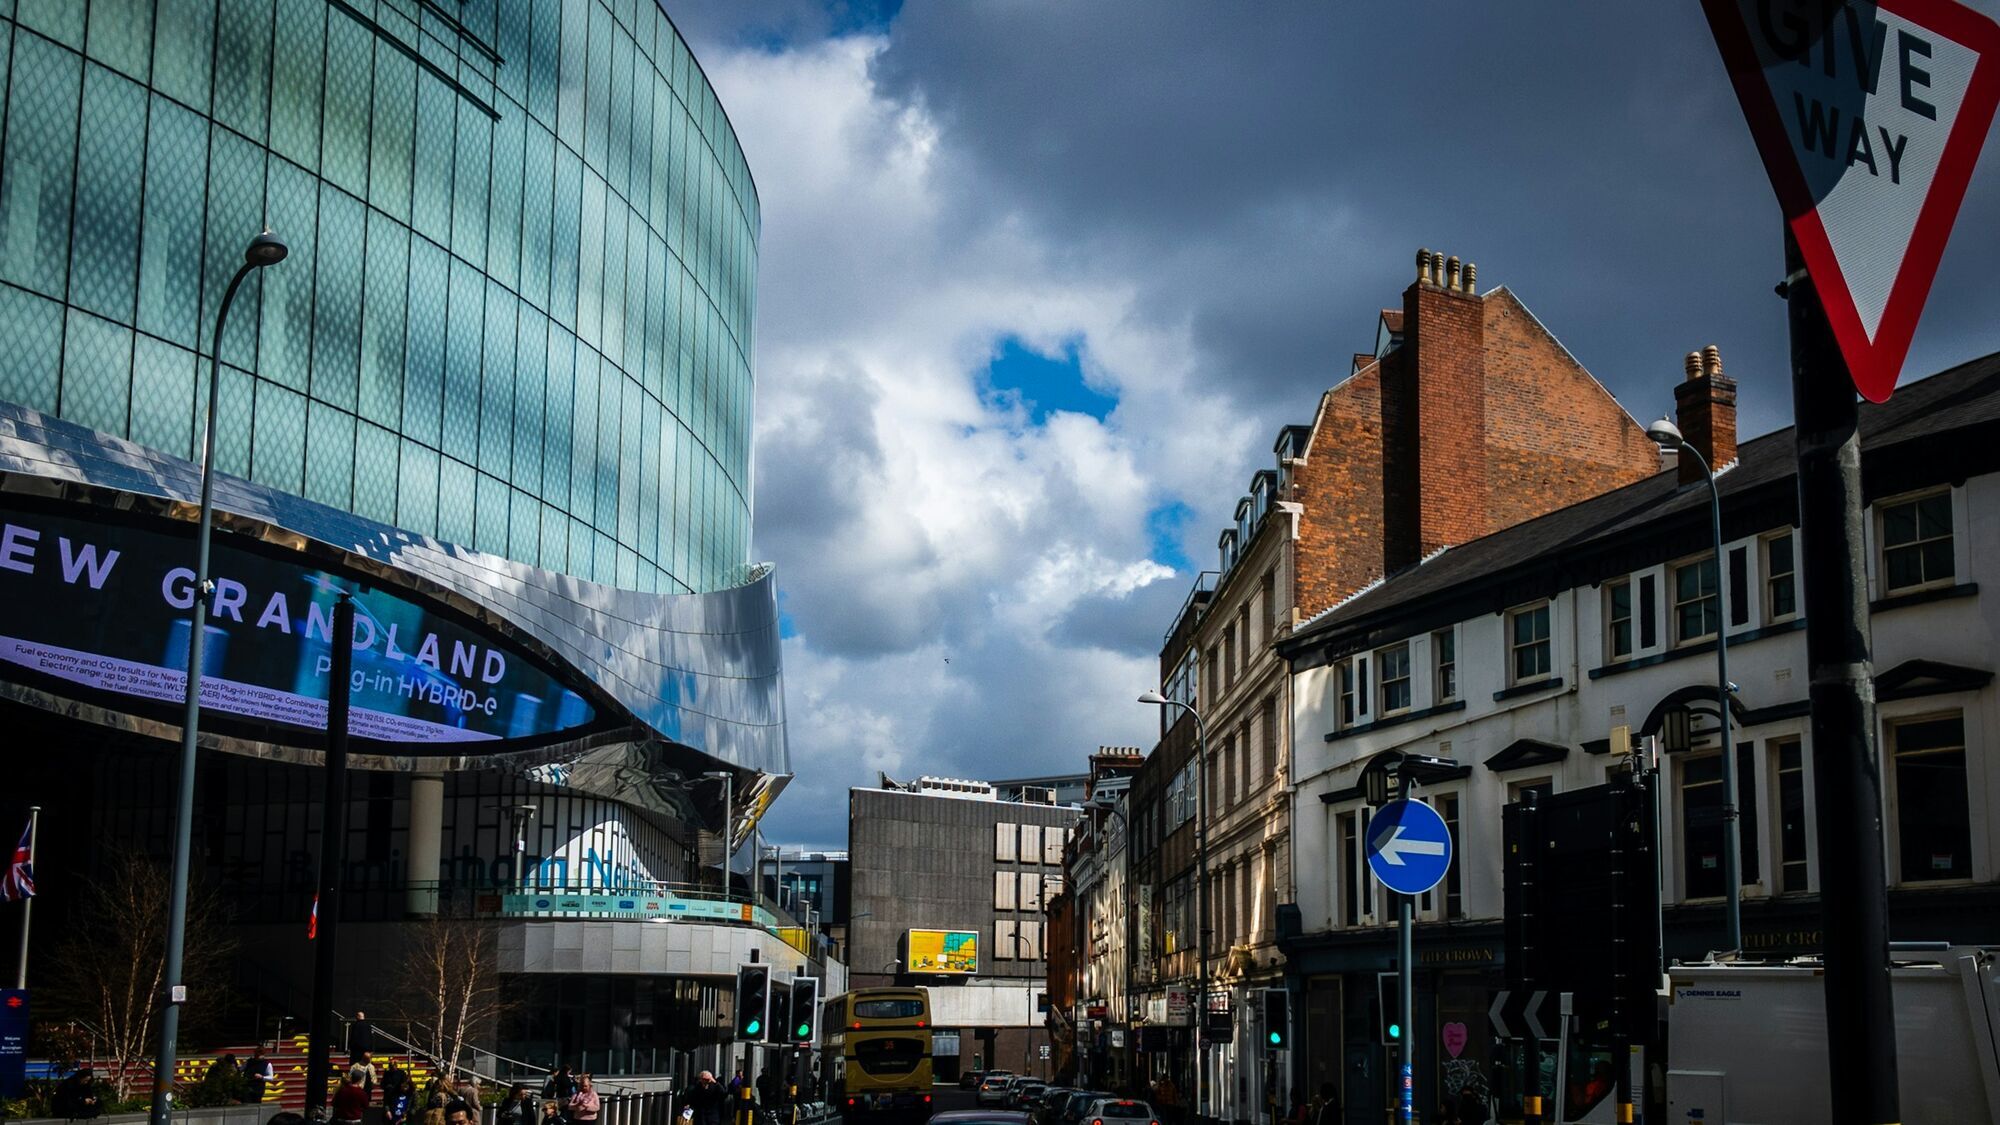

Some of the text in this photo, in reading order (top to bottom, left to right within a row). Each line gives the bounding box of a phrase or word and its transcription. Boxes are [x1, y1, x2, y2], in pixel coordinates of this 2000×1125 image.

[1757, 0, 1936, 121] GIVE
[1794, 92, 1908, 184] WAY
[0, 524, 508, 687] EW GRANDLAND
[15, 644, 36, 656] Fuel
[37, 650, 79, 665] economy
[81, 658, 97, 667] and
[118, 665, 146, 677] results
[147, 669, 159, 678] for
[160, 673, 178, 683] New
[221, 683, 247, 697] Plug-in
[285, 696, 319, 711] Combined
[40, 658, 74, 673] Electric
[104, 672, 116, 682] up
[117, 674, 126, 682] to
[128, 675, 139, 684] 39
[222, 693, 240, 703] Model
[241, 697, 259, 707] shown
[261, 701, 273, 709] New
[274, 704, 302, 716] Grandland
[100, 680, 113, 689] The
[114, 682, 127, 691] fuel
[233, 705, 249, 716] range
[314, 655, 497, 716] Pg-in HYBRID-e
[1446, 947, 1494, 961] CROWN
